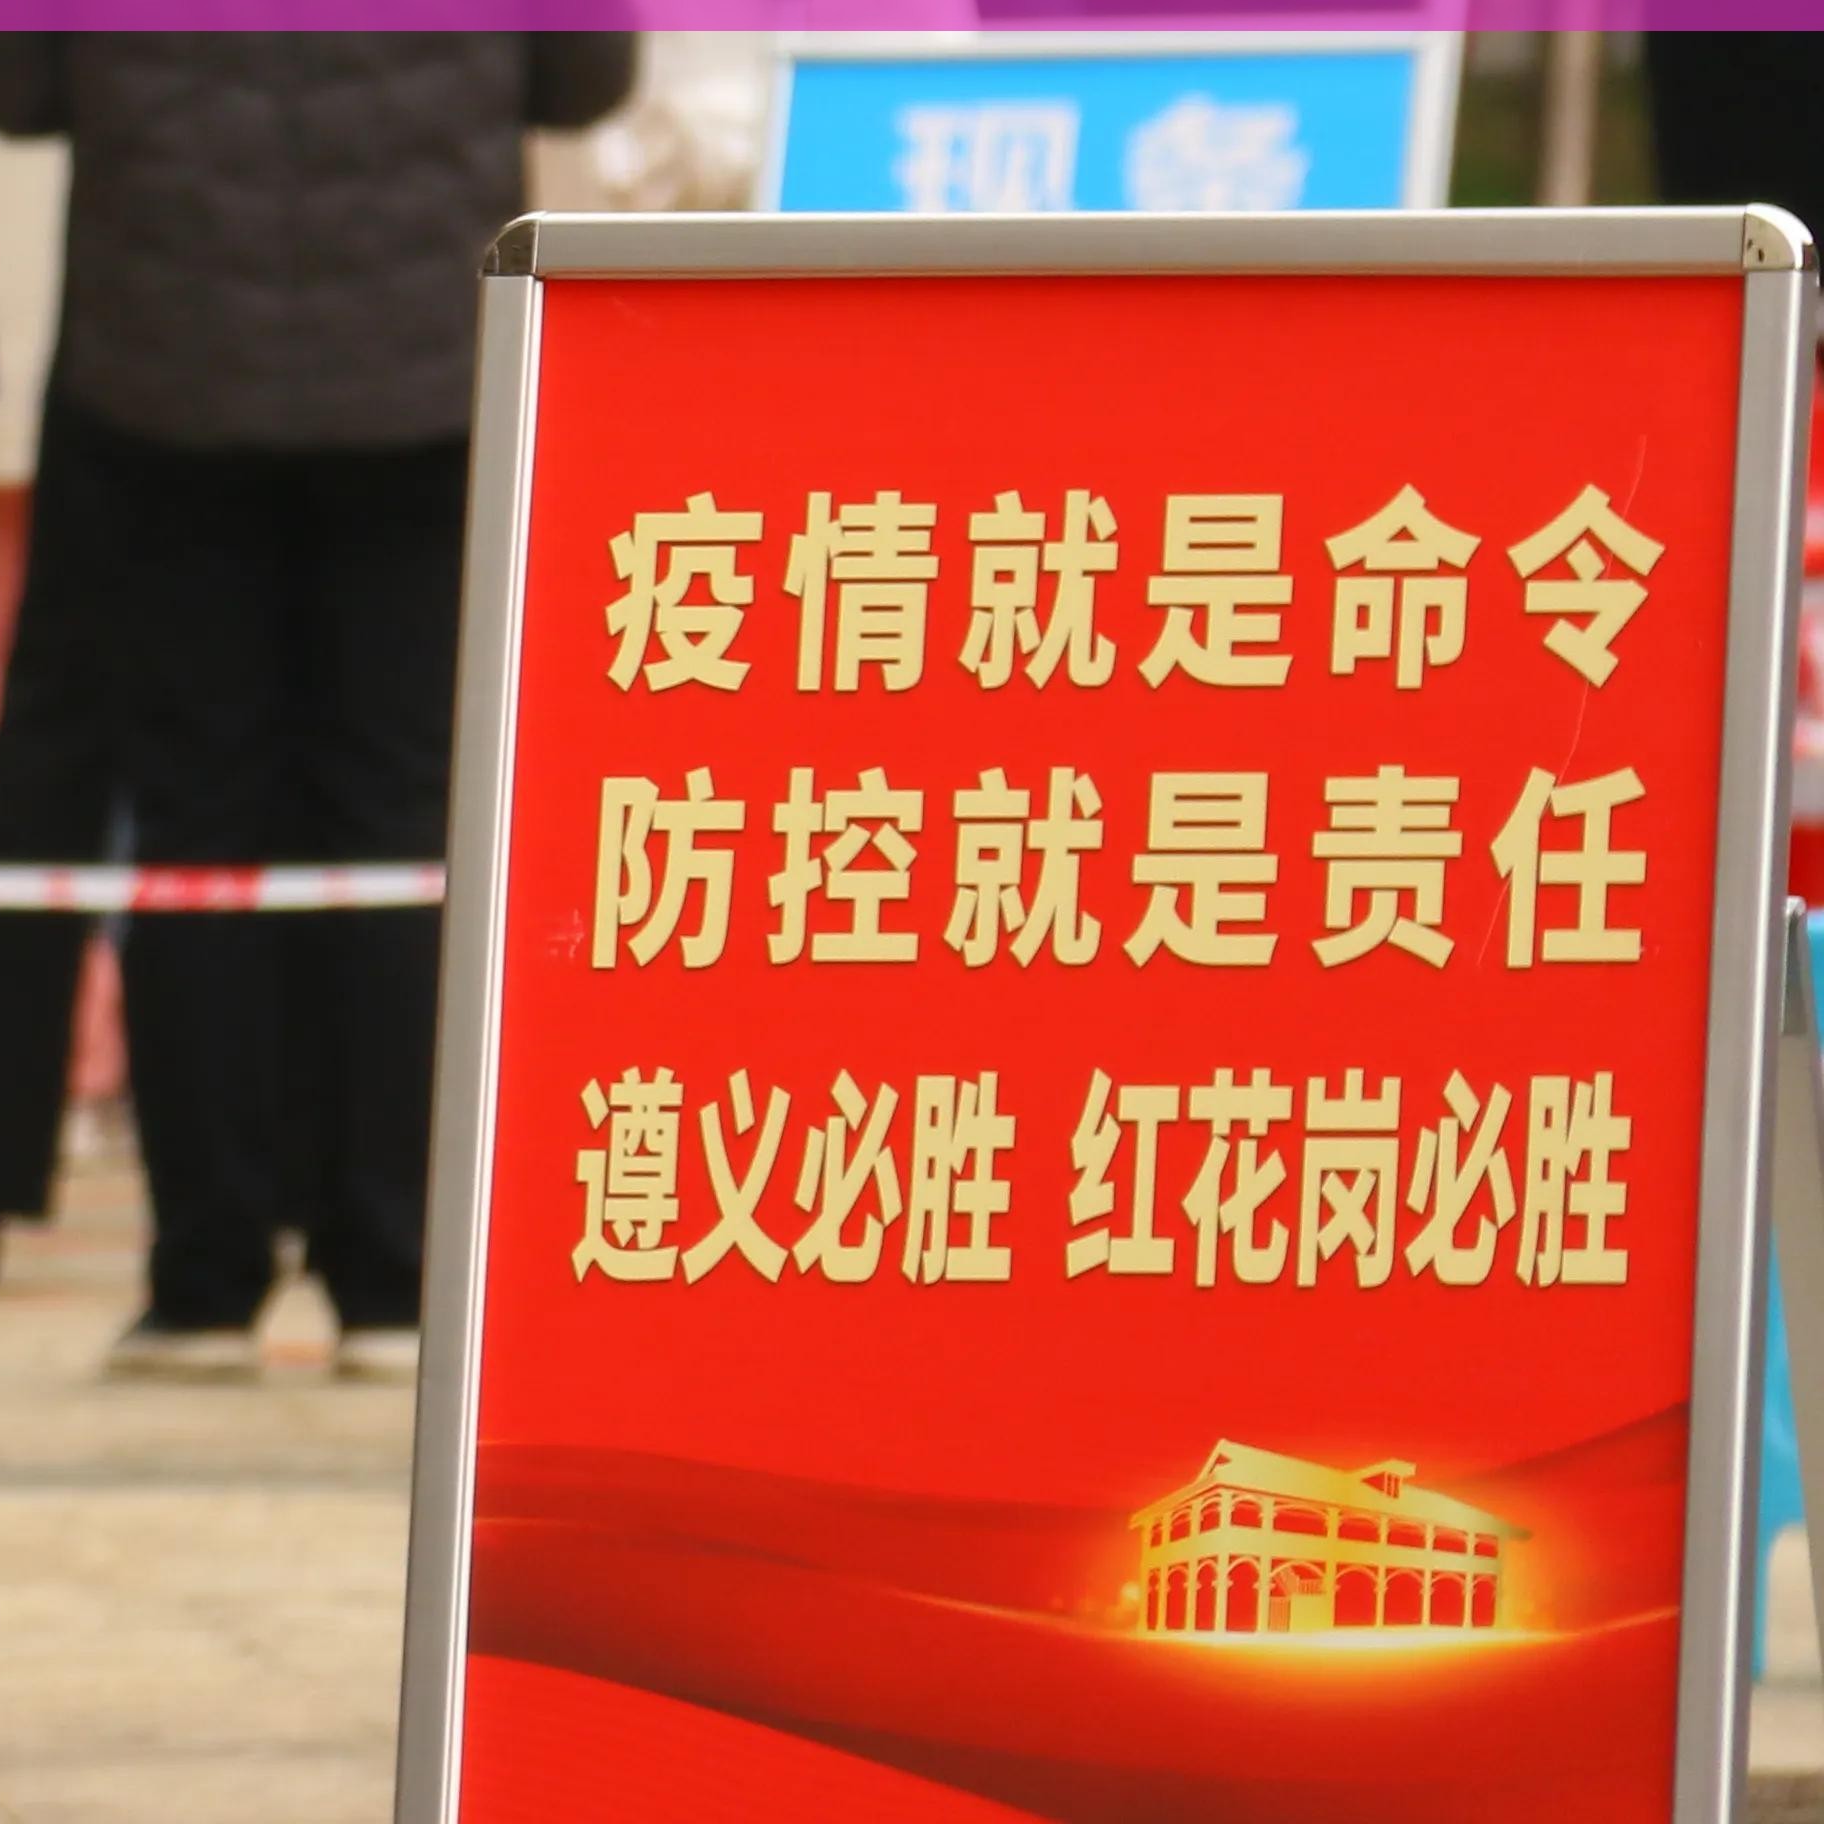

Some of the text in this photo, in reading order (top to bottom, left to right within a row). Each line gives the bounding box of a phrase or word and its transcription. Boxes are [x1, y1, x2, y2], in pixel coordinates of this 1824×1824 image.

[605, 483, 1666, 693] 疫情就是命令
[590, 764, 1648, 970] 防控就是责任
[570, 1066, 1633, 1289] 遵义必胜 红花岗必胜
